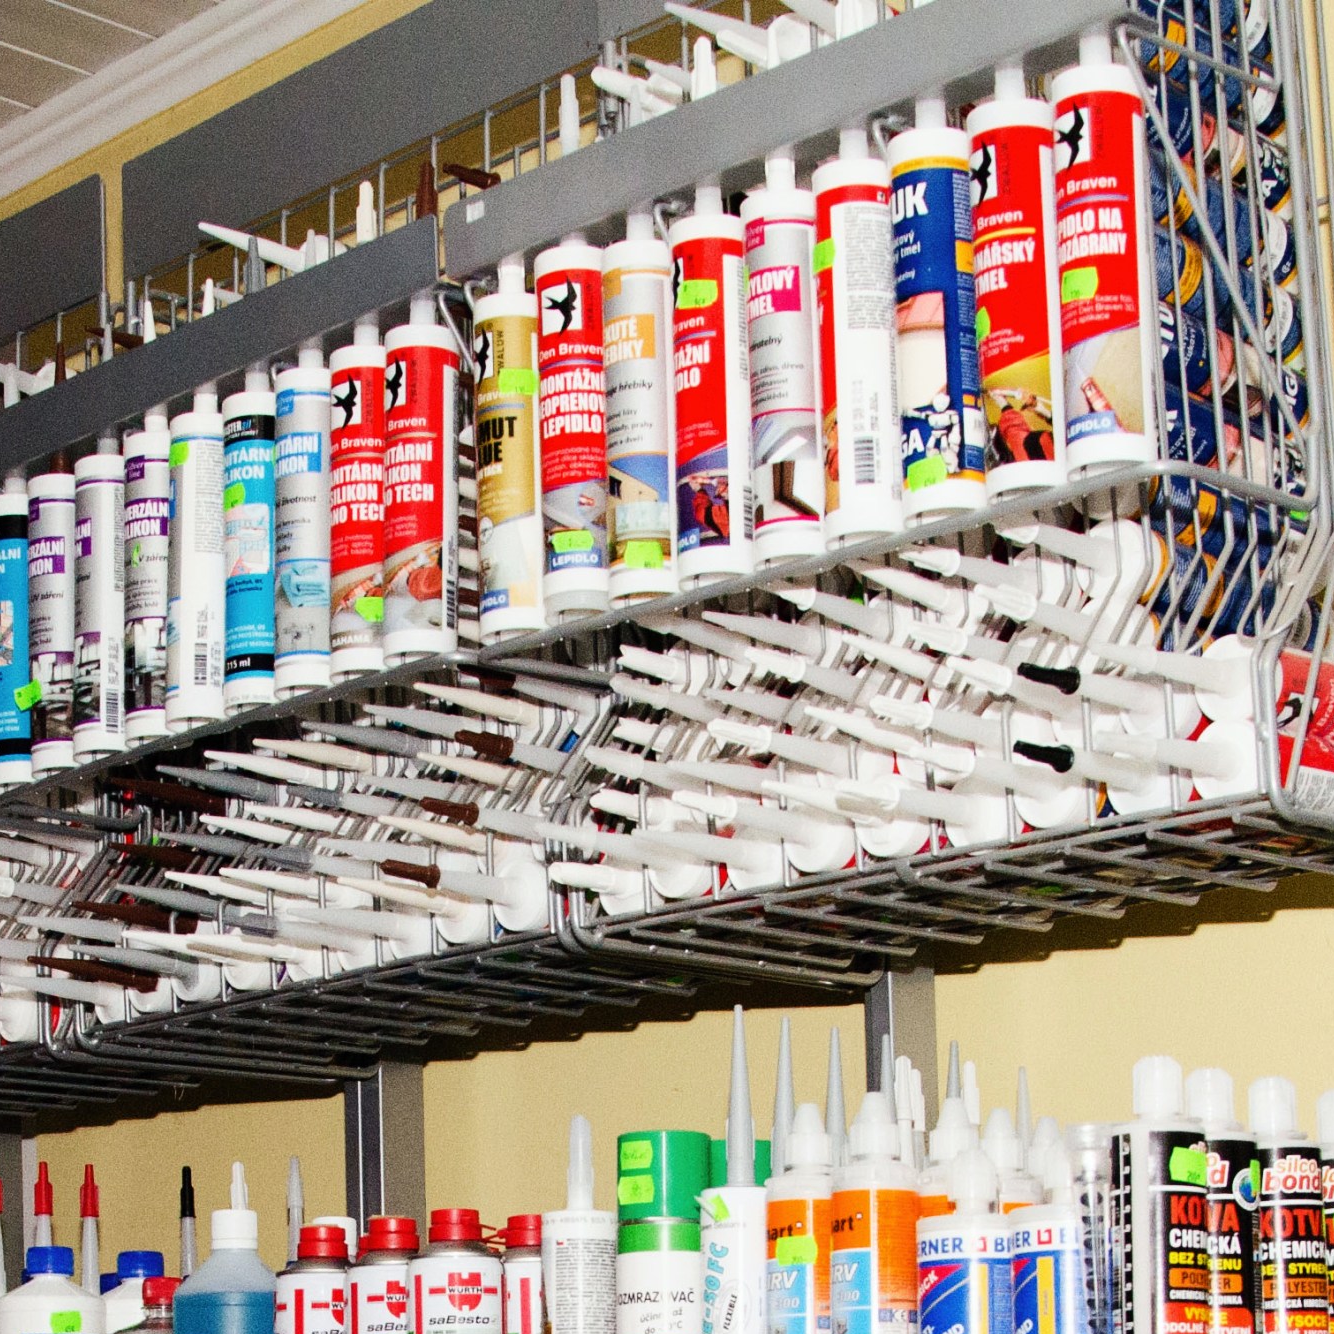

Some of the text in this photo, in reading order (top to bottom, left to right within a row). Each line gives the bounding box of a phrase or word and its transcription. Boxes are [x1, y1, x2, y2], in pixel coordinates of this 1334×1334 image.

[1067, 175, 1118, 195] Braven
[978, 209, 1023, 230] Braven
[1098, 207, 1123, 231] NA
[388, 417, 427, 431] Braven
[543, 413, 602, 440] LEPIDLO
[1068, 417, 1111, 440] LEPIDLO
[341, 437, 383, 450] Braven
[395, 483, 434, 504] TECH
[551, 552, 599, 568] LEPIDLO
[1275, 1155, 1318, 1175] silco
[1169, 1251, 1194, 1264] BEZ
[428, 1313, 491, 1326] saBesto
[722, 1293, 739, 1331] FLEXIBLE
